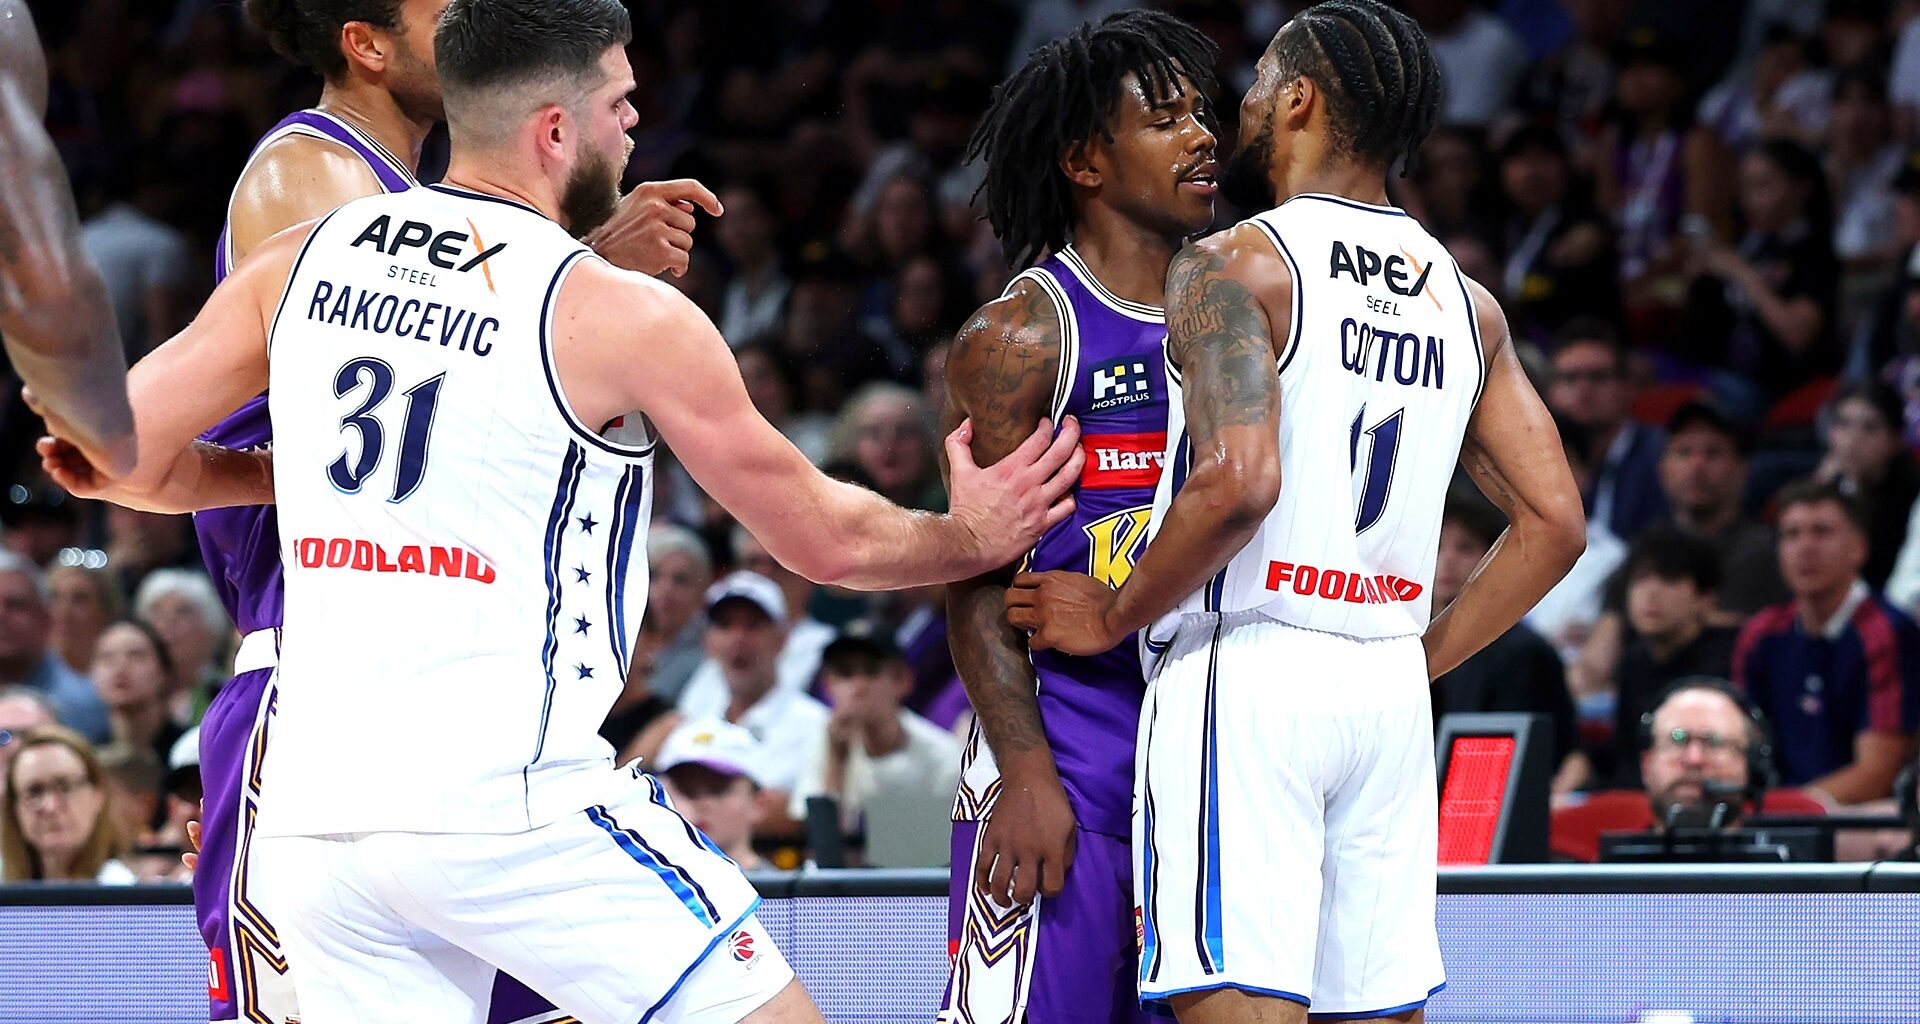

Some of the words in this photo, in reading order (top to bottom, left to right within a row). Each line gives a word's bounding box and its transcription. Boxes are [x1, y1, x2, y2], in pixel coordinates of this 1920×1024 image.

[350, 214, 508, 298] APEX
[387, 265, 437, 287] STEEL
[1329, 240, 1443, 312] APEX
[307, 280, 500, 357] RAKOCEVIC
[1366, 295, 1401, 316] SEEL
[1091, 392, 1150, 410] HOSTPLUS
[326, 356, 446, 504] 31
[294, 537, 496, 584] OODLAND
[1265, 559, 1423, 604] FOODAND
